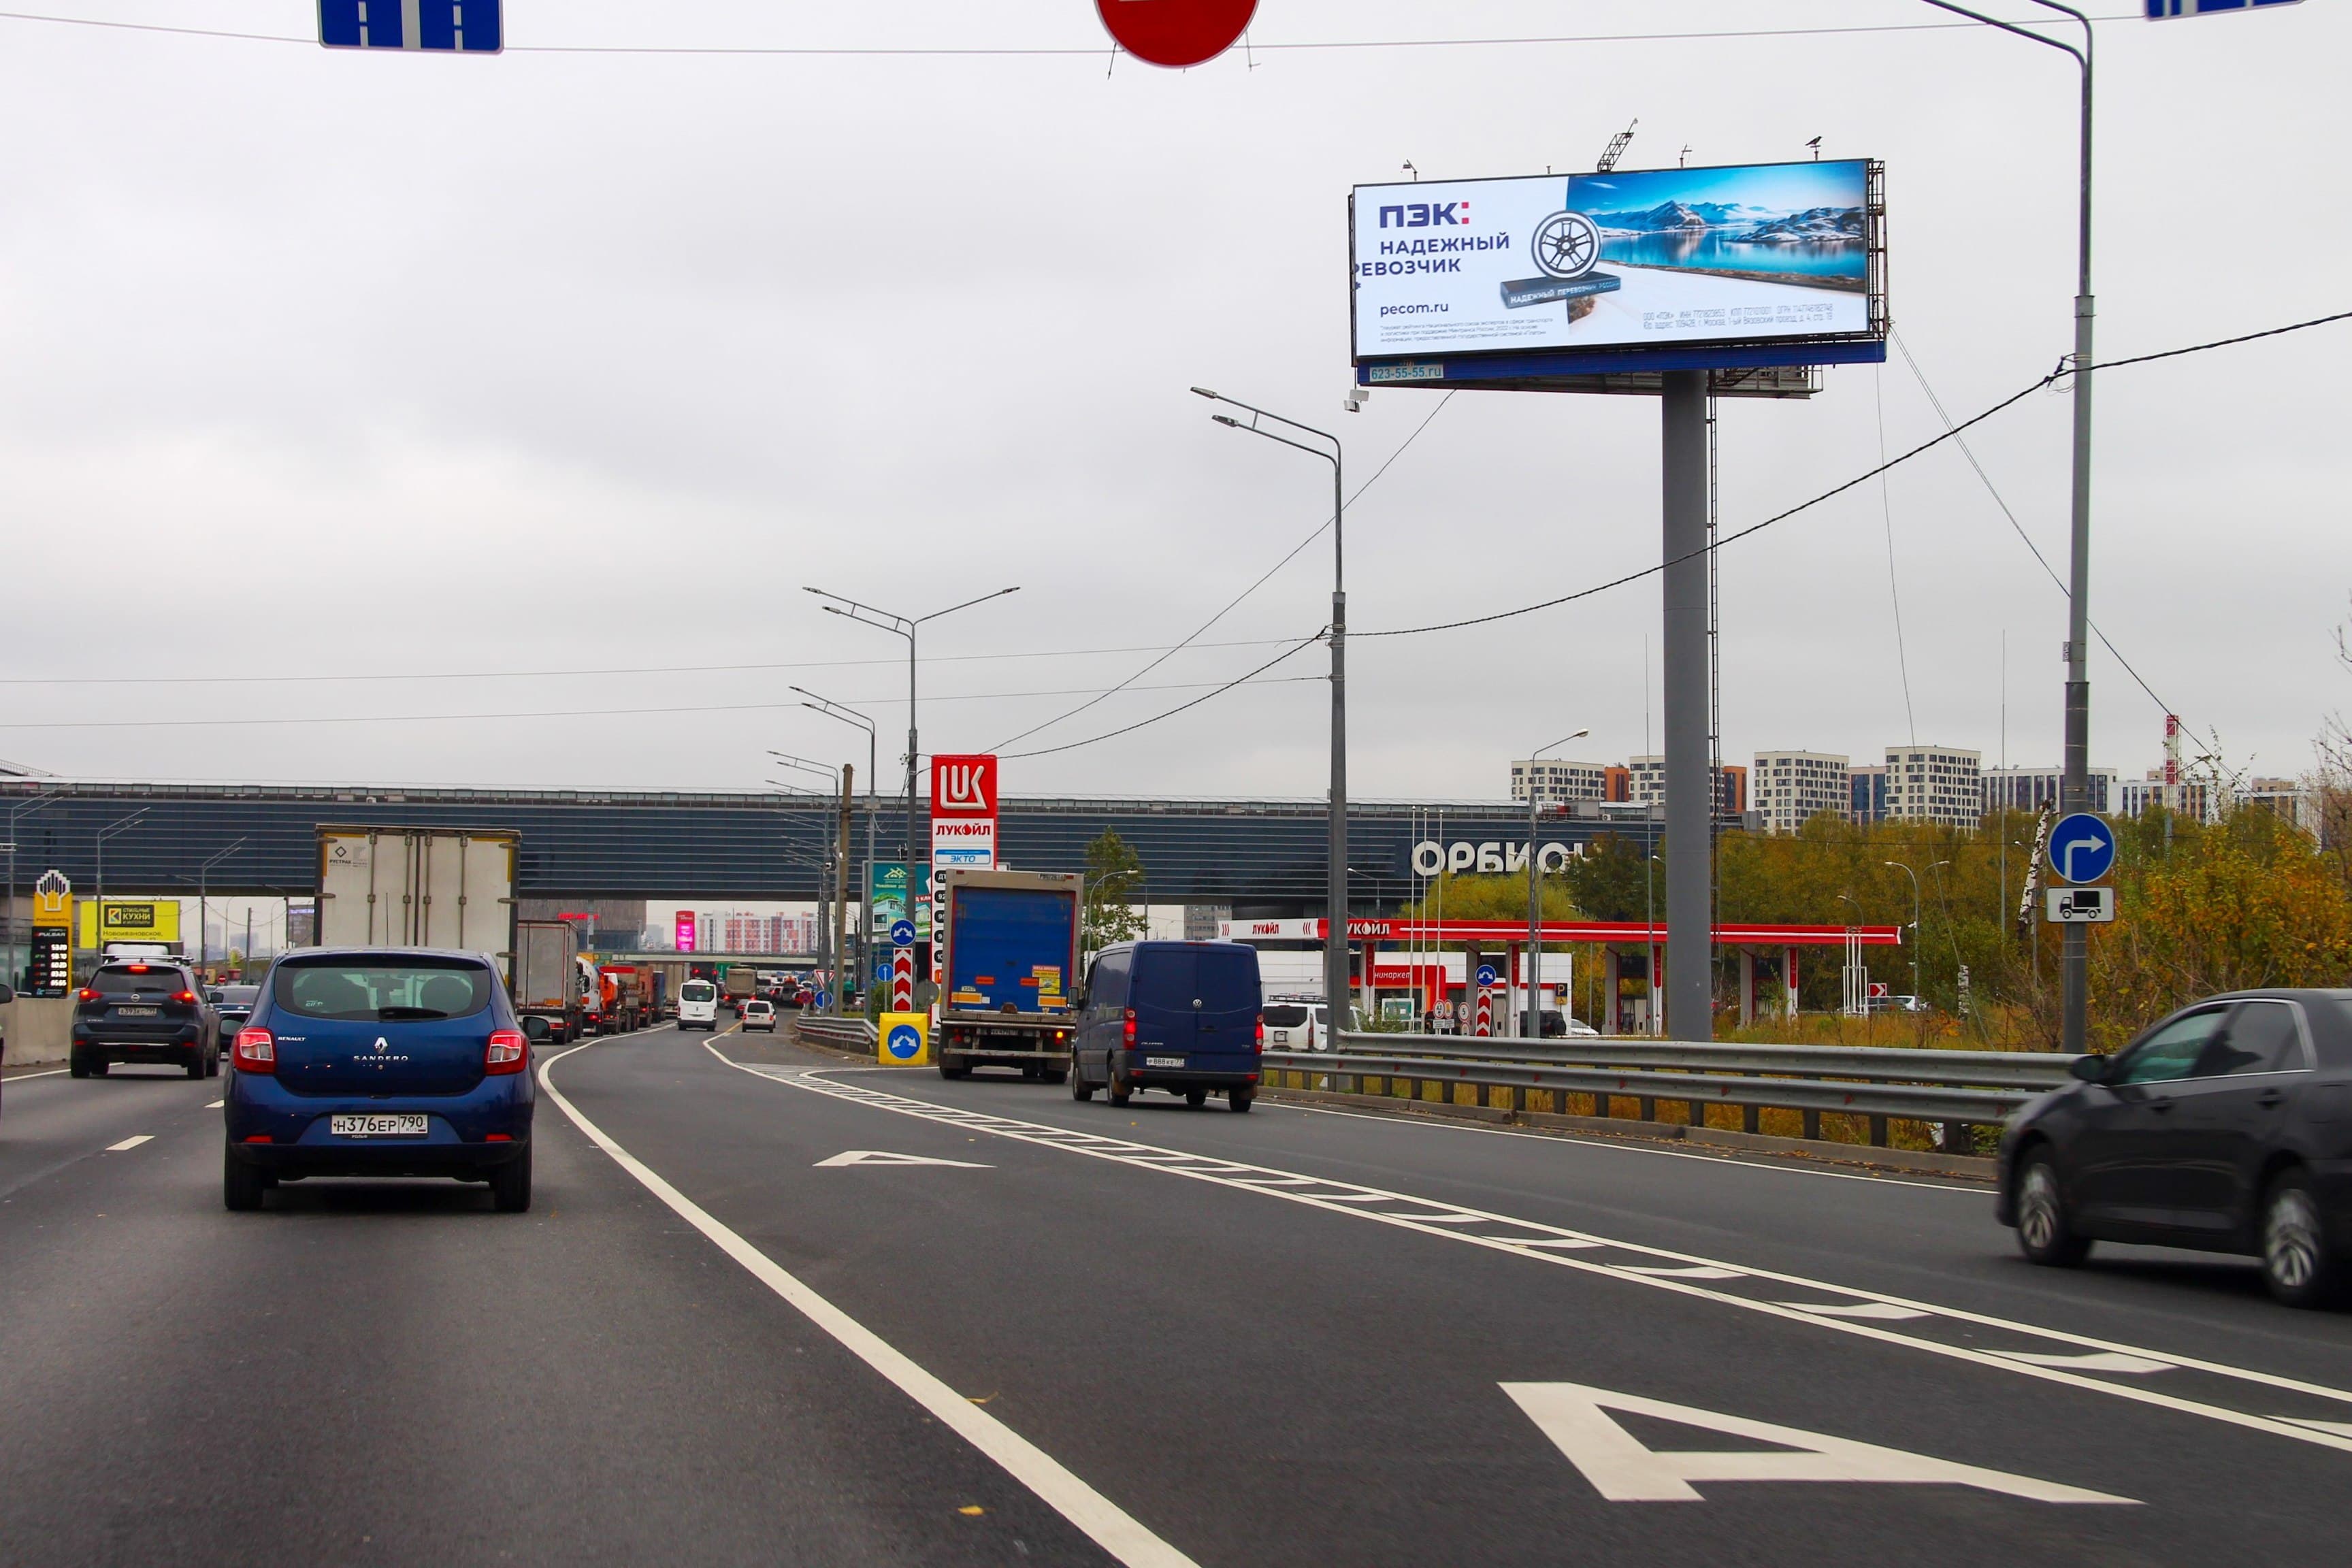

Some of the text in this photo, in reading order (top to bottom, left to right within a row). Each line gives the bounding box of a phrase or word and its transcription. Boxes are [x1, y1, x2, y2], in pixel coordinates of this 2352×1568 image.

[1380, 231, 1510, 256] НАДЕЖНЫЙ
[1380, 303, 1449, 318] pecom.ru
[1371, 368, 1441, 380] 623-55-55.ru
[936, 823, 990, 836] ЛУКОЙЛ
[950, 855, 976, 863] ЭКТО
[1347, 919, 1390, 935] УКОЙЛ
[337, 1116, 423, 1132] Н376ЕР 790
